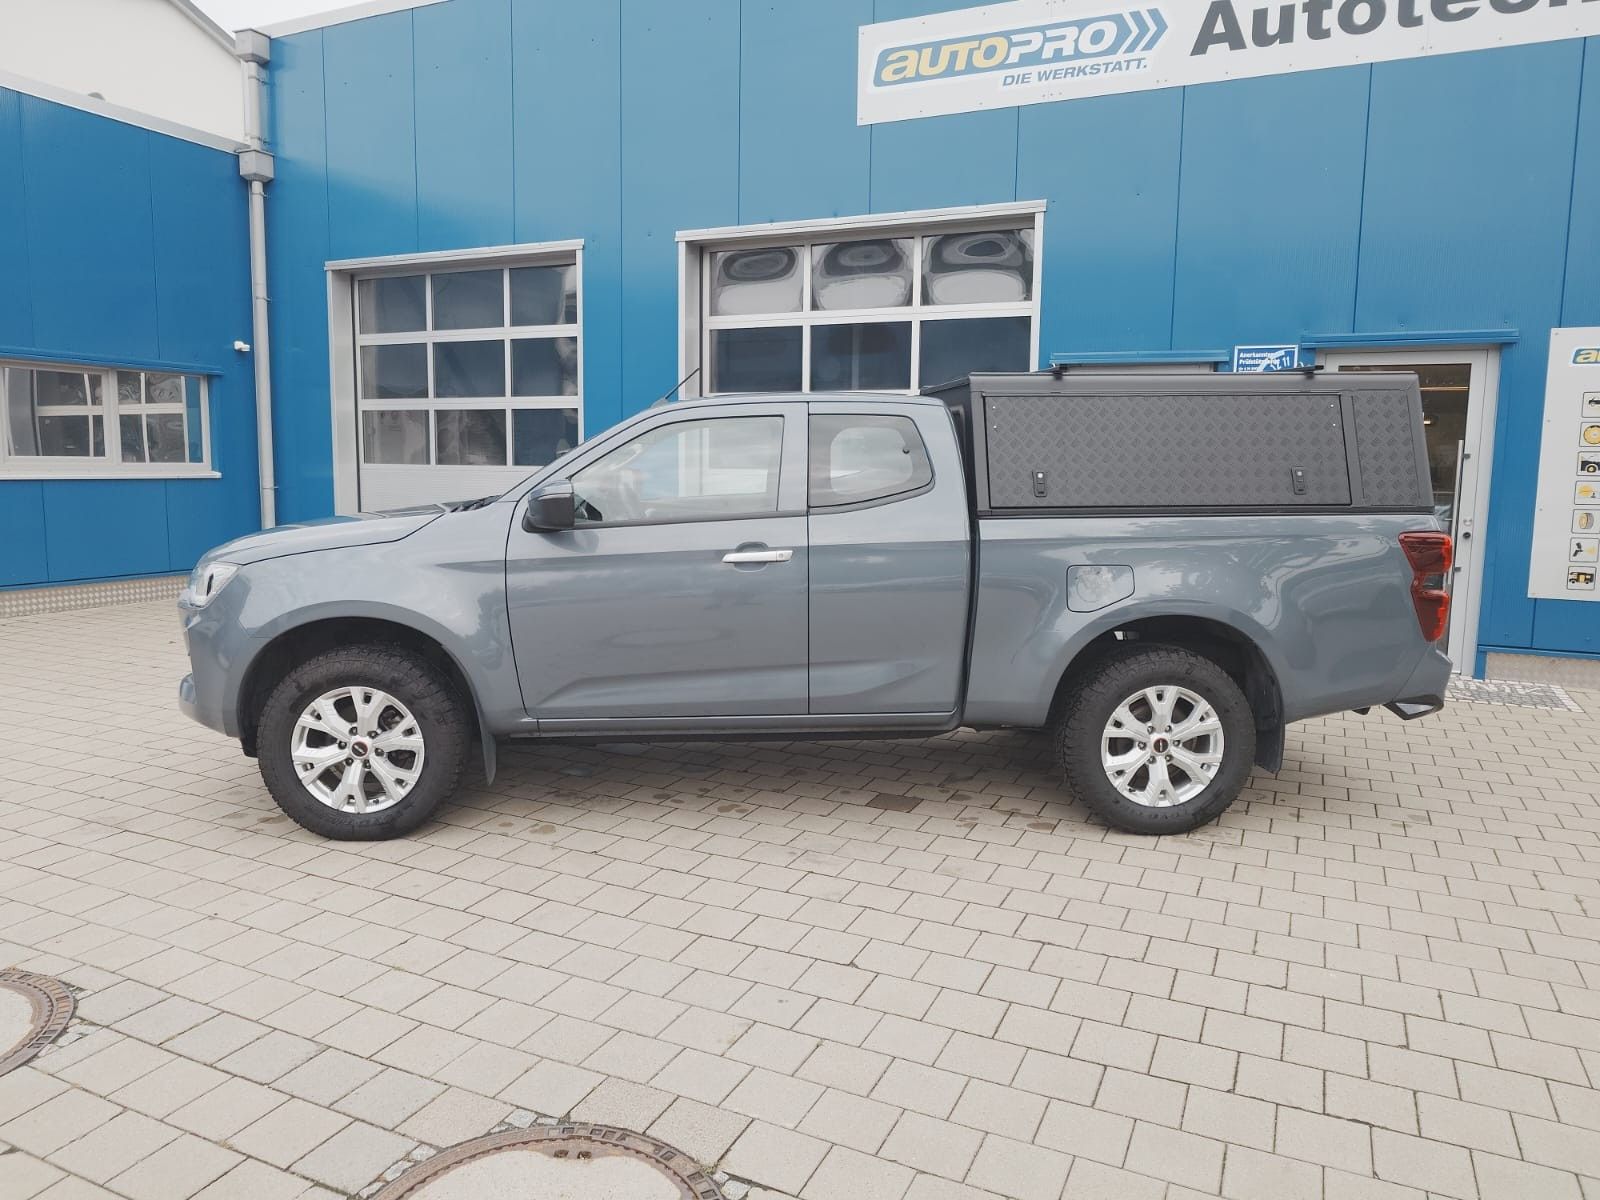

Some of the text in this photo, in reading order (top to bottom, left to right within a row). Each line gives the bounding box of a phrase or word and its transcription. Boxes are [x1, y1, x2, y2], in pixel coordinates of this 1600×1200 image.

[1190, 0, 1600, 56] Autote
[1002, 57, 1147, 87] DIE WERKSTATT.
